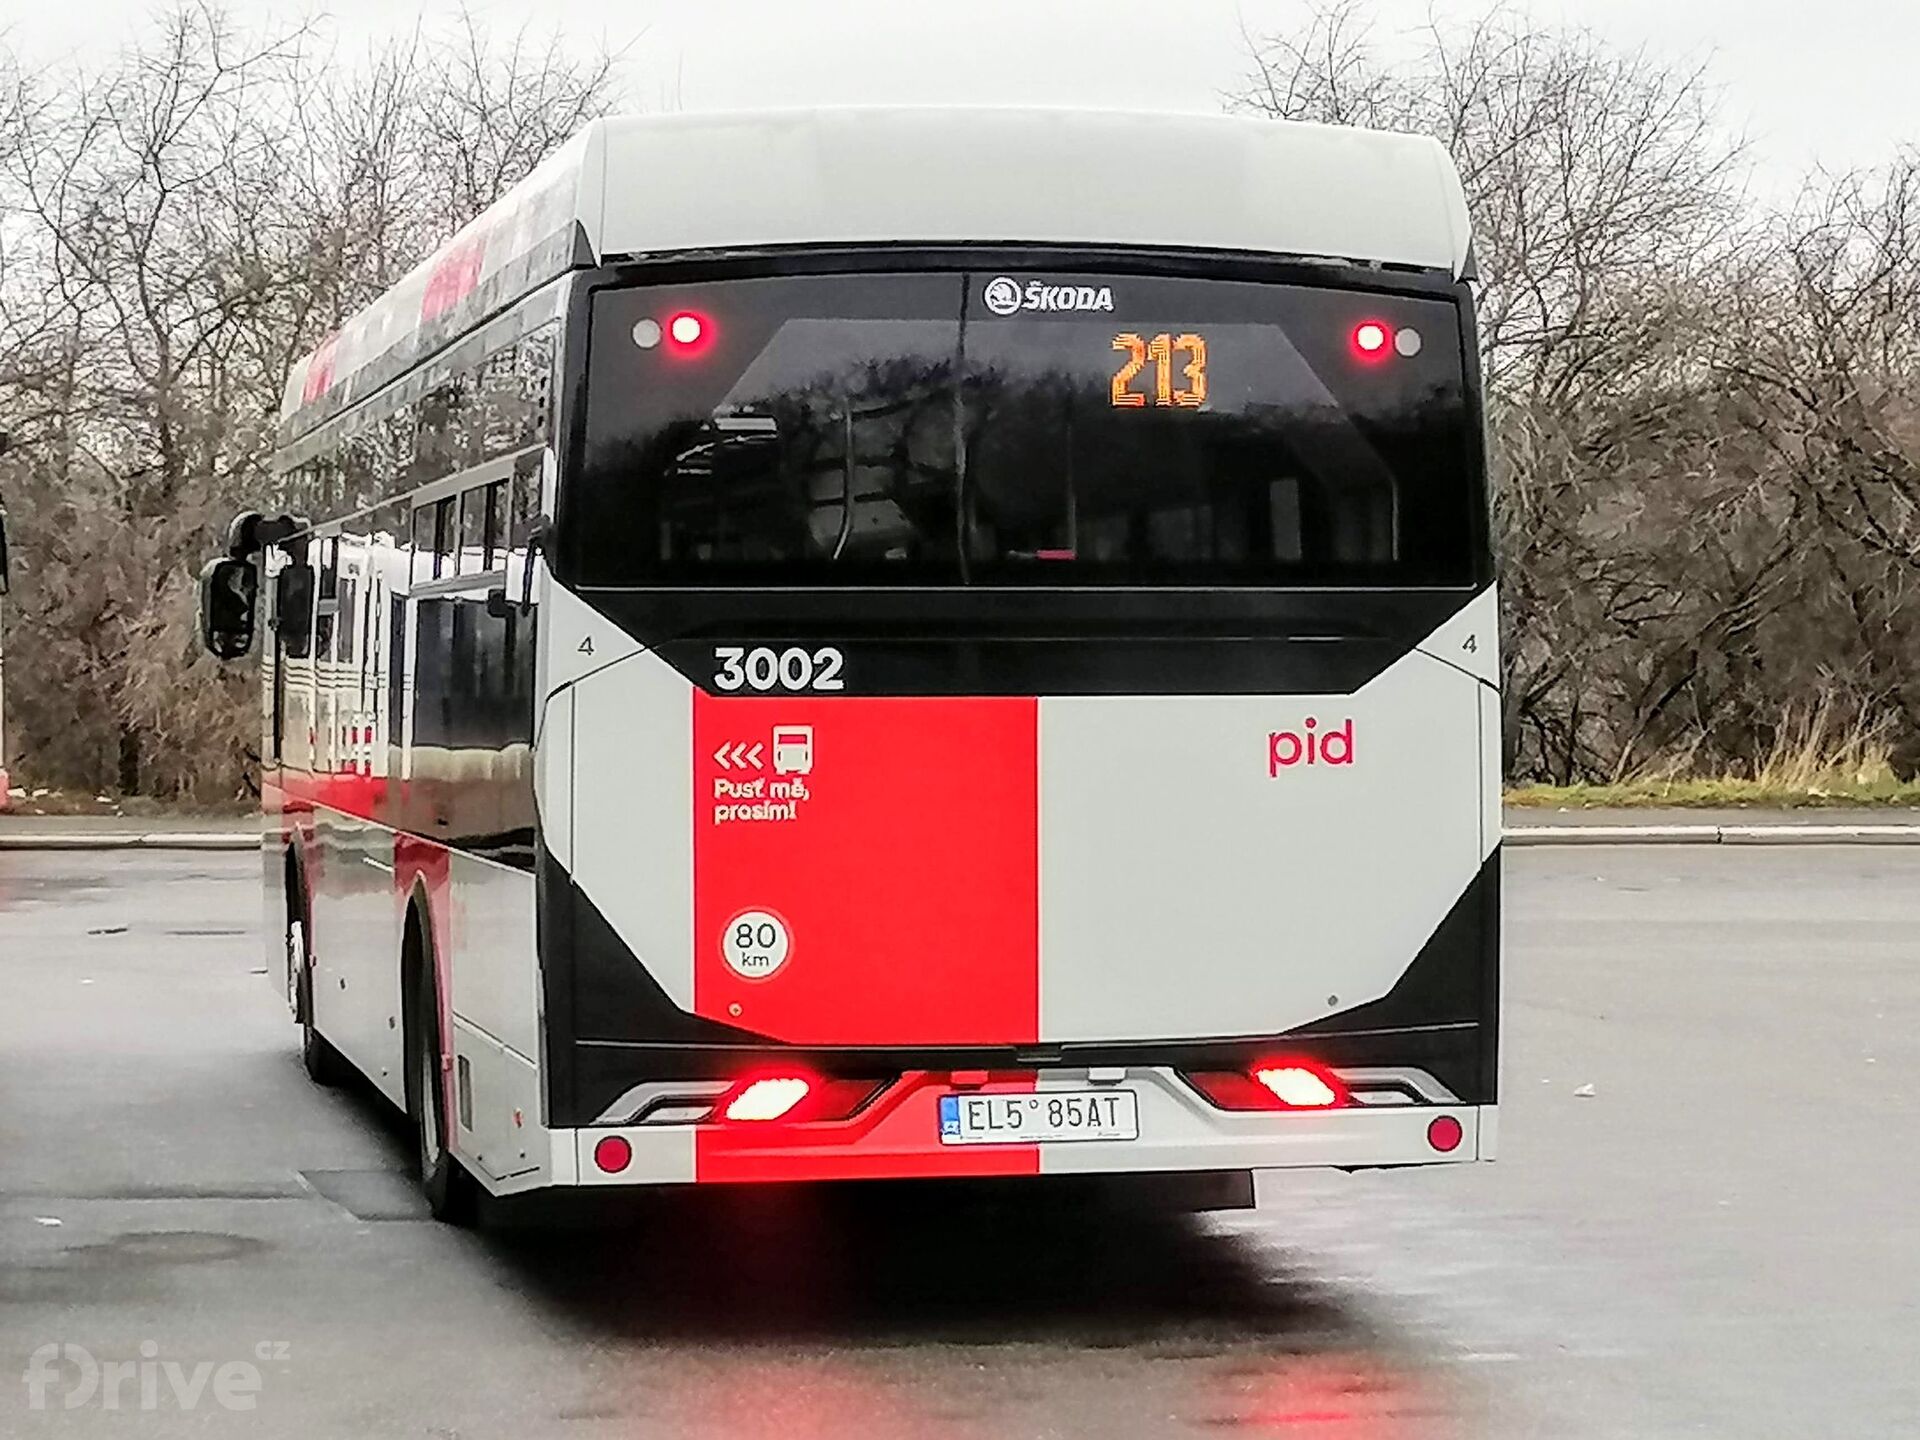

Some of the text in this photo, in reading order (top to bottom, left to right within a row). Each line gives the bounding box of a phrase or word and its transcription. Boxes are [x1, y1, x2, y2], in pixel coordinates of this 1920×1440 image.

[1022, 279, 1115, 312] ŠKODA
[1110, 332, 1209, 407] 213
[578, 635, 596, 656] 4
[1462, 633, 1478, 653] 4
[713, 647, 845, 691] 3002
[1268, 717, 1355, 778] pid
[735, 923, 777, 949] 80
[741, 951, 770, 967] km
[968, 1099, 1023, 1131] EL5
[1048, 1096, 1120, 1128] 85AT
